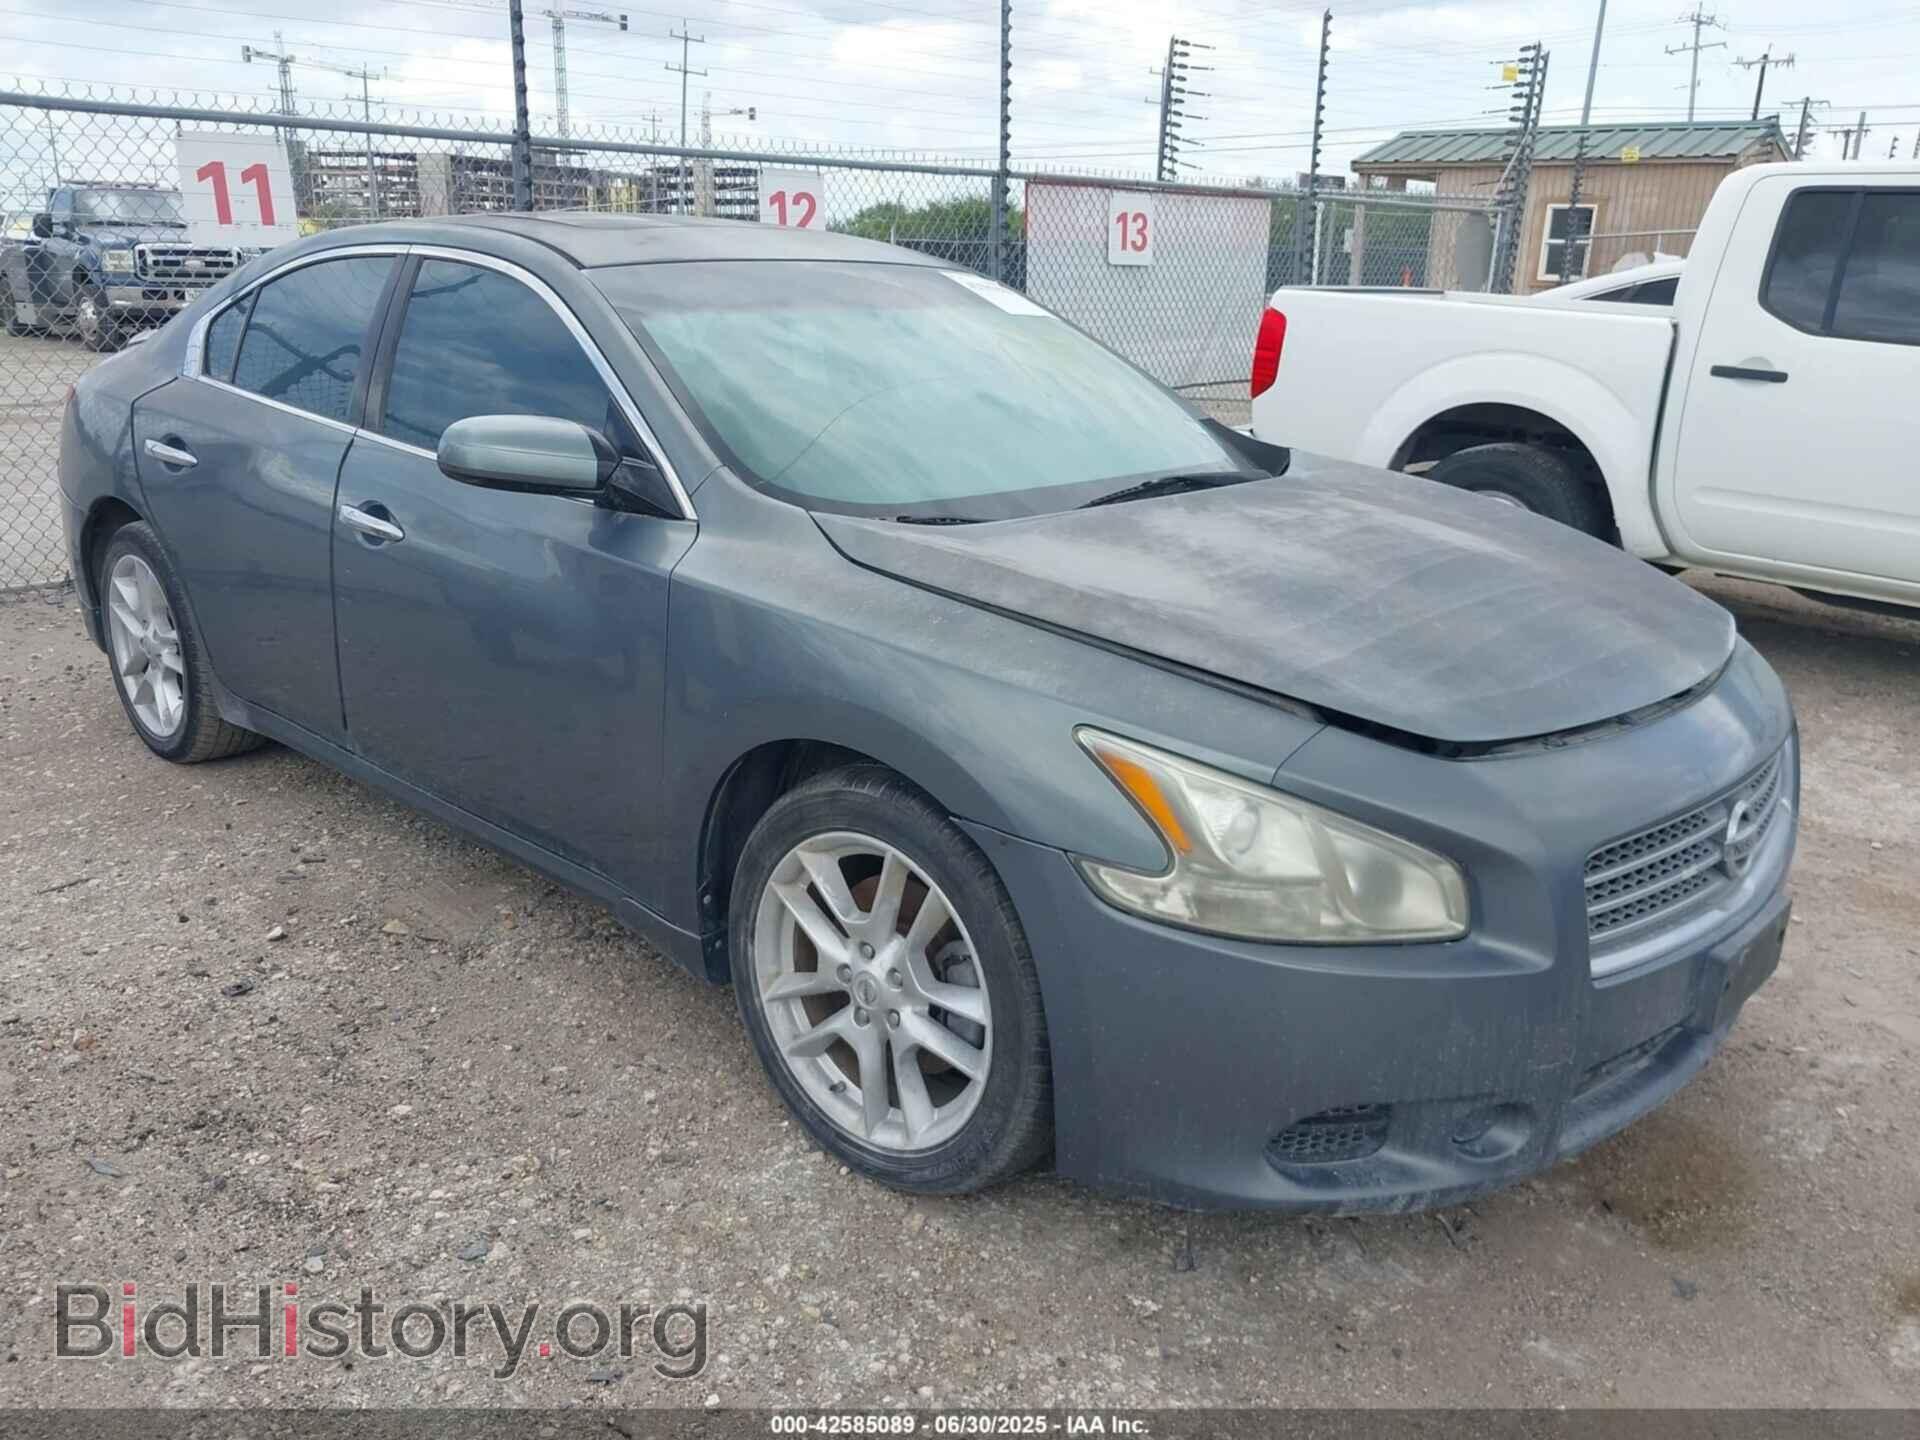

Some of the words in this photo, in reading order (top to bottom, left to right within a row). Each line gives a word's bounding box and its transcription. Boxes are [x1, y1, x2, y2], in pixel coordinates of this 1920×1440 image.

[196, 160, 276, 226] 11
[768, 190, 817, 229] 12
[1115, 211, 1148, 252] 13
